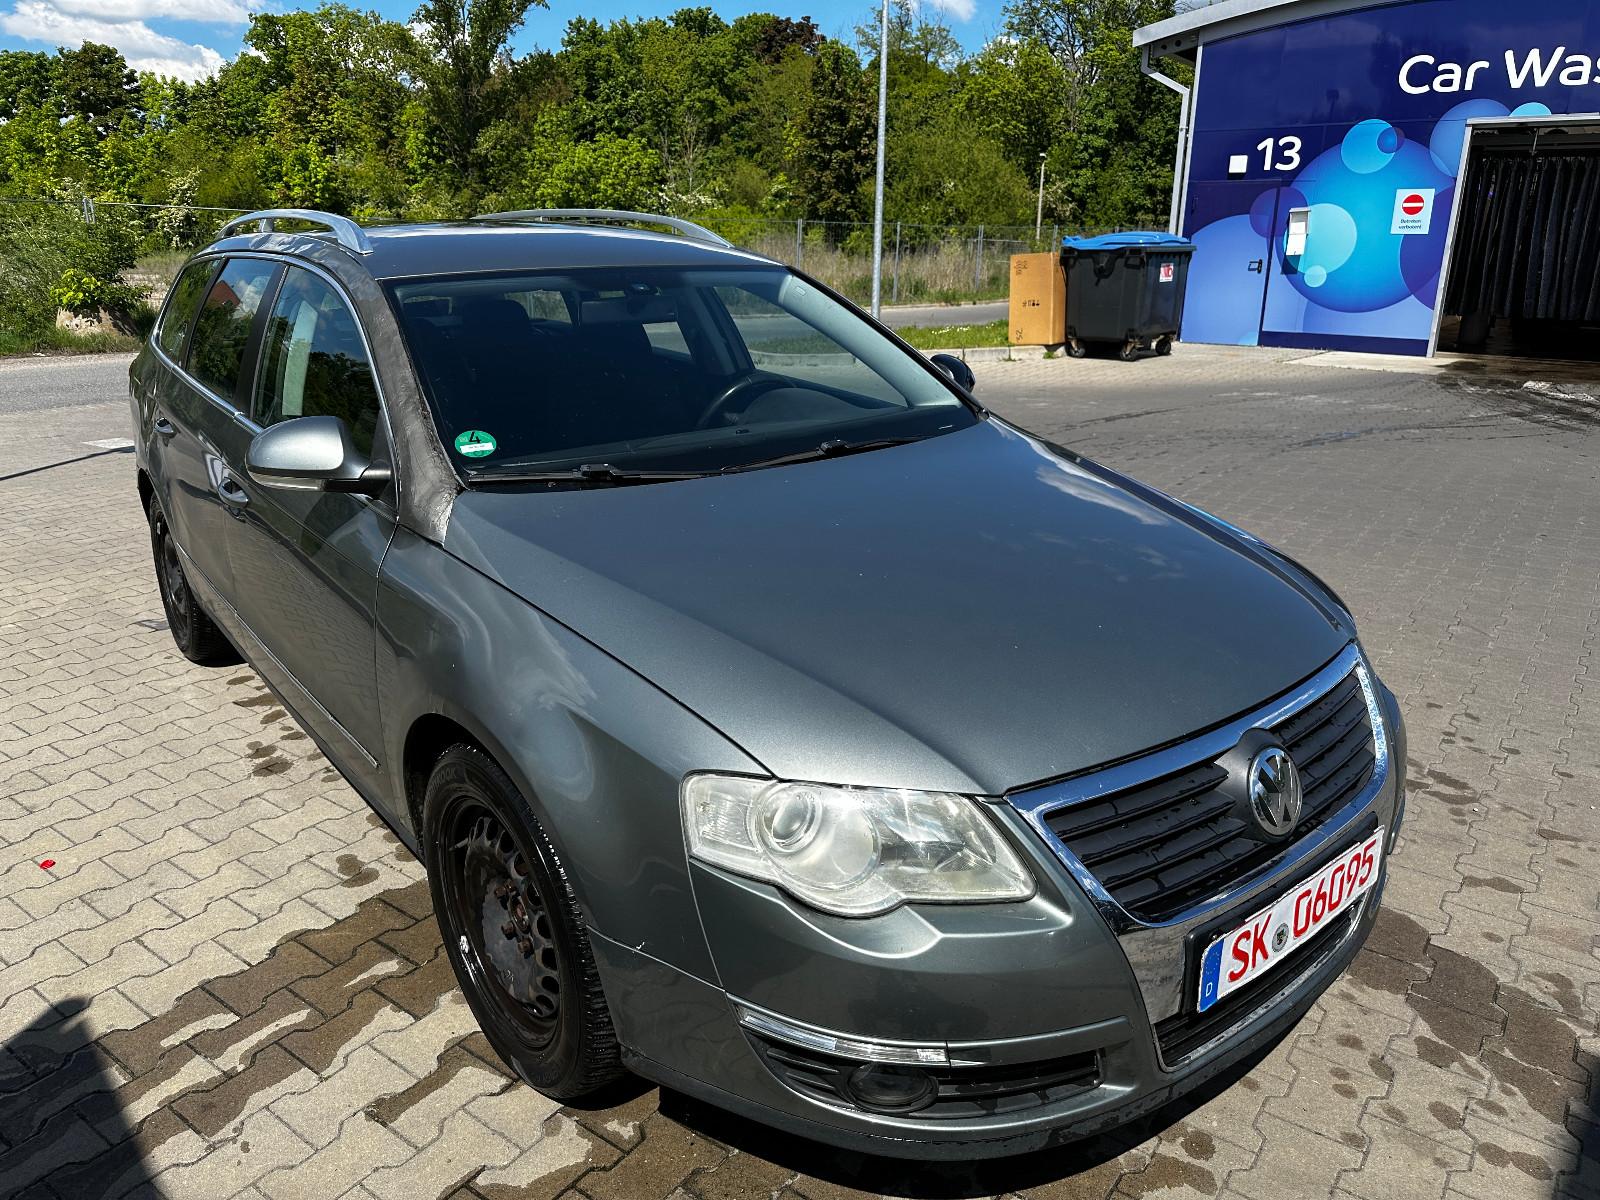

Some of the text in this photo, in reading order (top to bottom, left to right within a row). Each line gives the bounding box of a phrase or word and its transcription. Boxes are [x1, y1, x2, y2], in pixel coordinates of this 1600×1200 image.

[1397, 54, 1490, 94] Car
[1256, 136, 1302, 172] 13
[469, 431, 481, 443] 4
[1228, 838, 1377, 983] SK 06095
[1205, 981, 1213, 997] D
